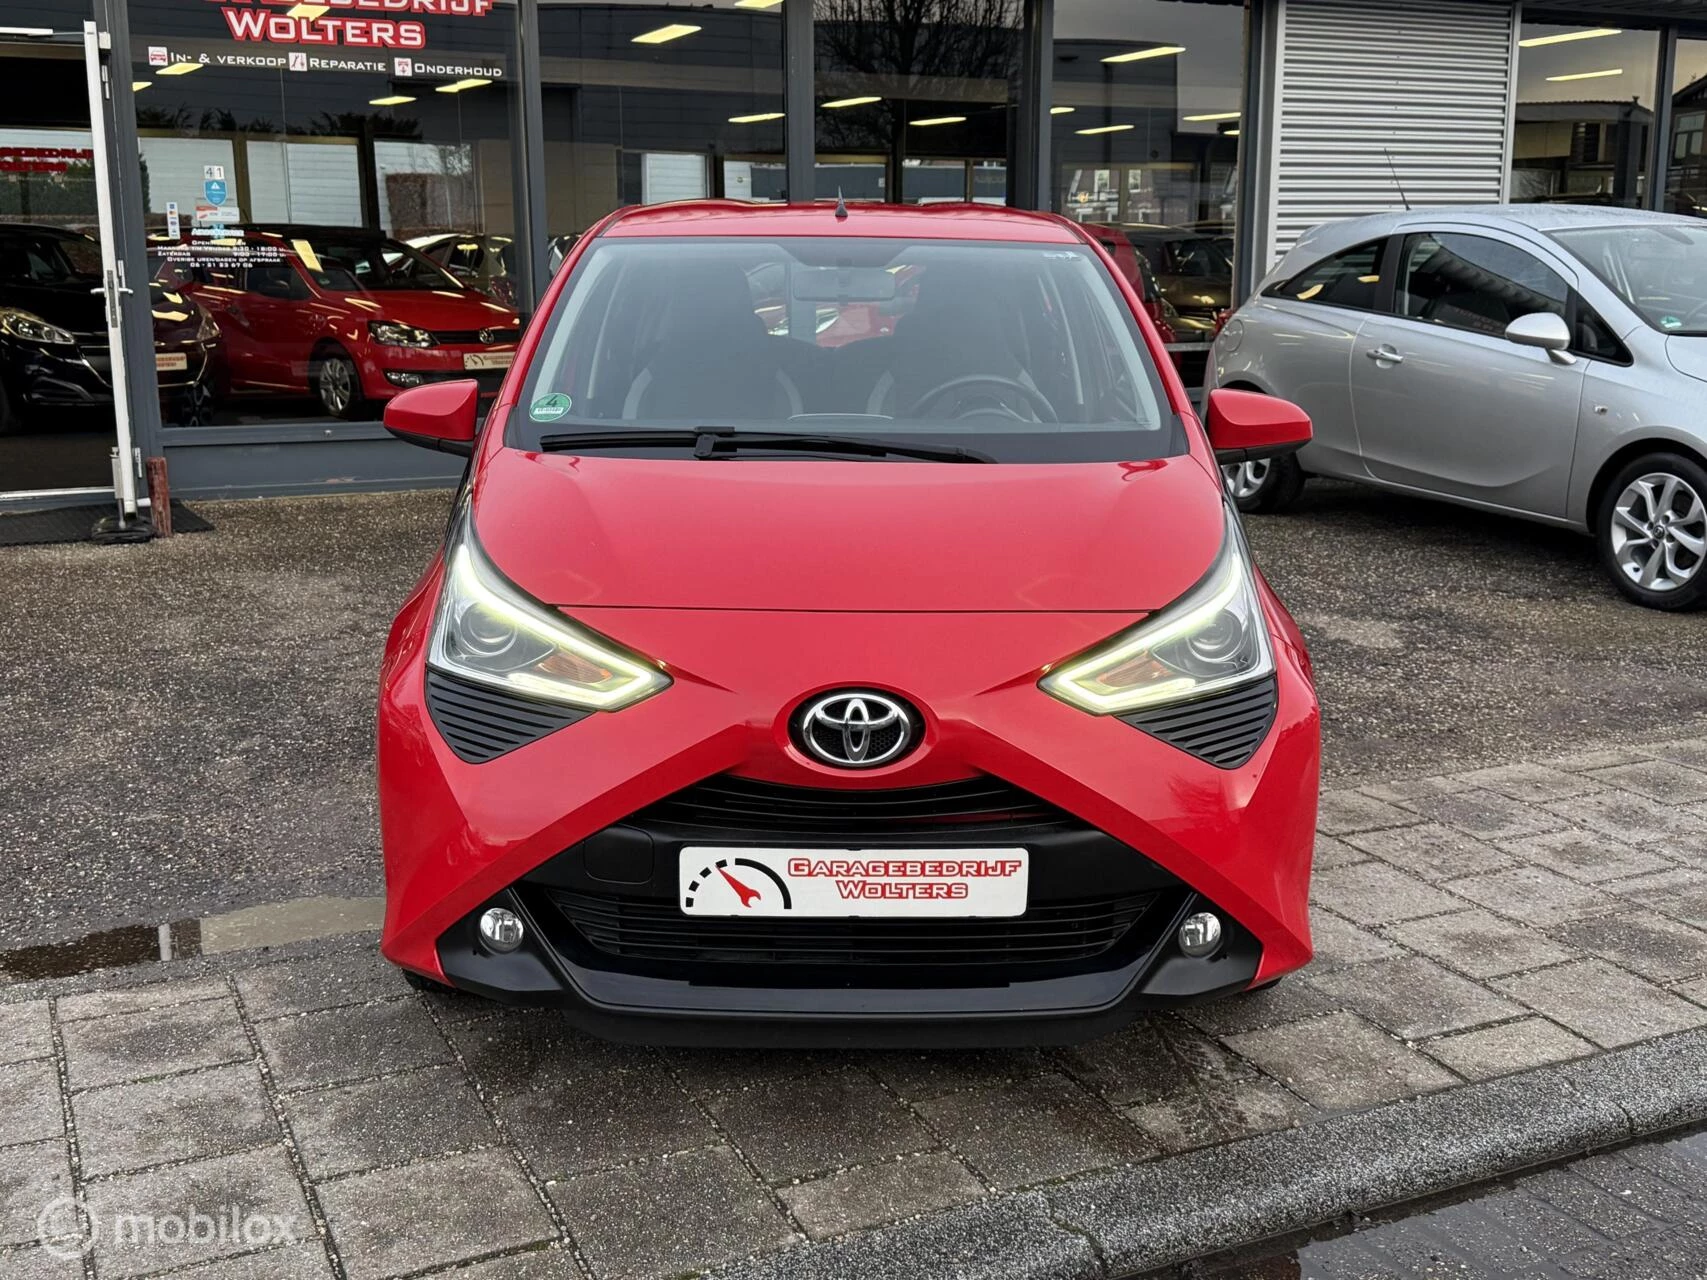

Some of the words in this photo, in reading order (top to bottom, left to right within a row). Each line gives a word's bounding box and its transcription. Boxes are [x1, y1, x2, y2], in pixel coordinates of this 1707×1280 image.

[222, 7, 426, 48] WOLTERS
[199, 53, 210, 64] &
[216, 55, 287, 66] VERKOOP
[309, 58, 386, 72] REPARATIE
[414, 63, 503, 77] ONDERHOUD
[545, 395, 558, 407] 4
[788, 858, 1022, 877] GARAGEBEDRIJF
[836, 880, 968, 899] WOLTERS
